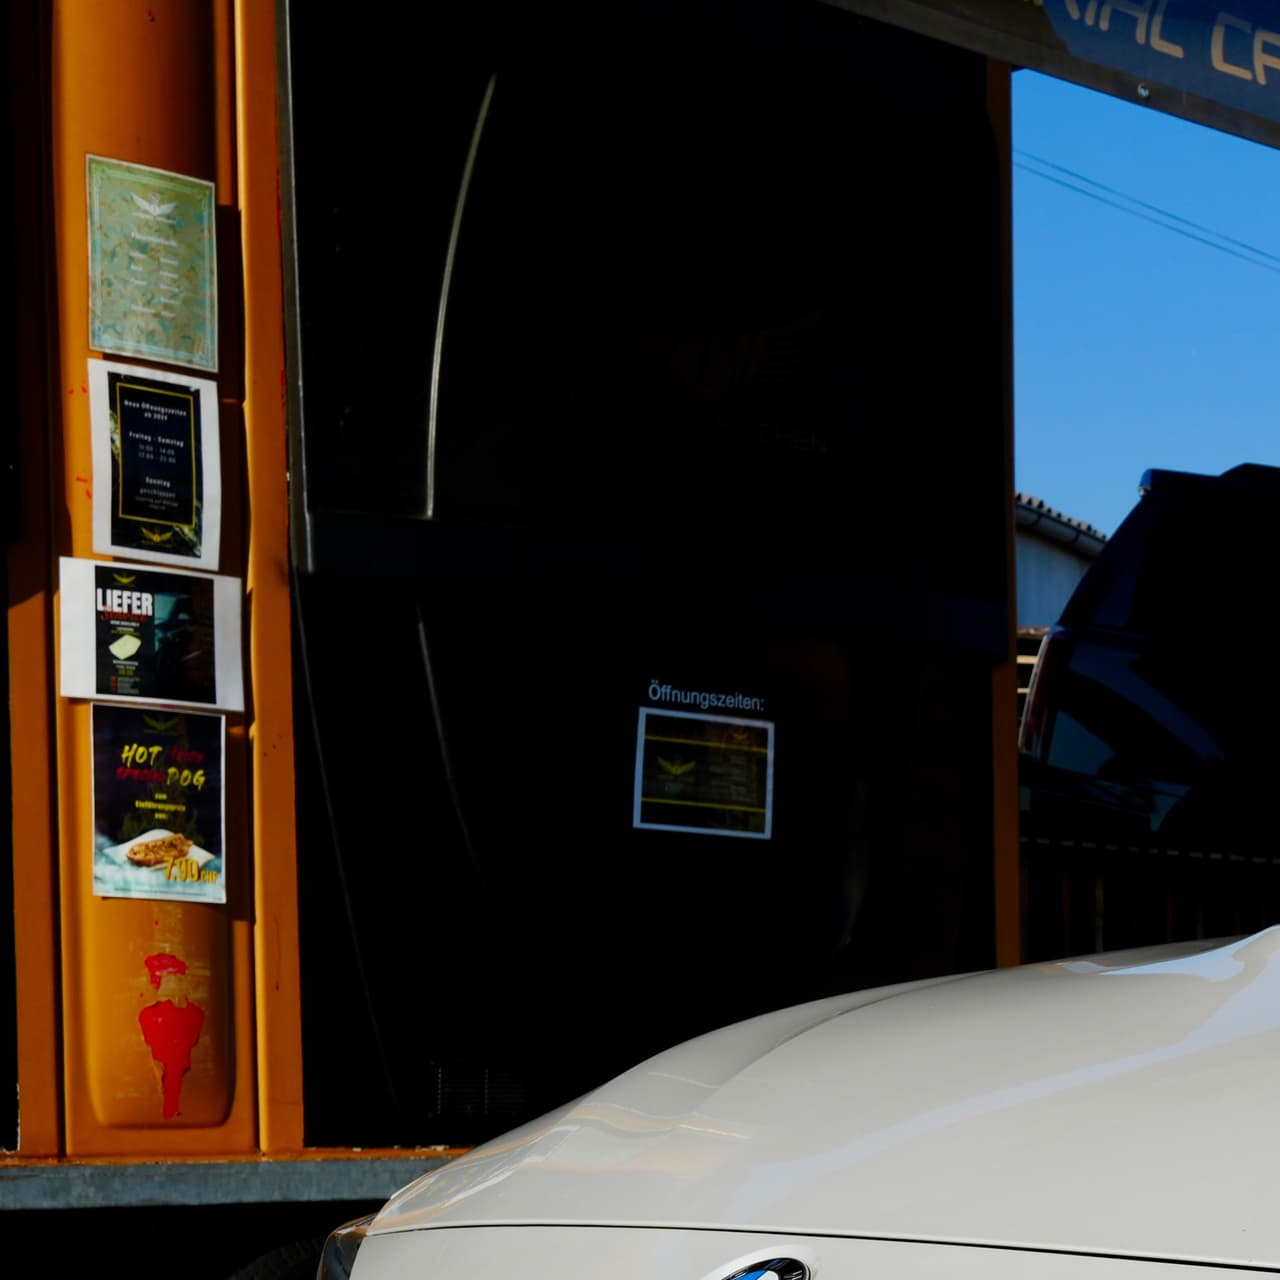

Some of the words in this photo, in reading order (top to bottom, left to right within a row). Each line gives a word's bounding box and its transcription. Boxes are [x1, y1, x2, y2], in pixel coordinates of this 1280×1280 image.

[96, 586, 154, 617] LIEFER
[647, 678, 765, 712] Öffnungszeiten:
[120, 742, 163, 769] HOT
[165, 766, 207, 792] DOG
